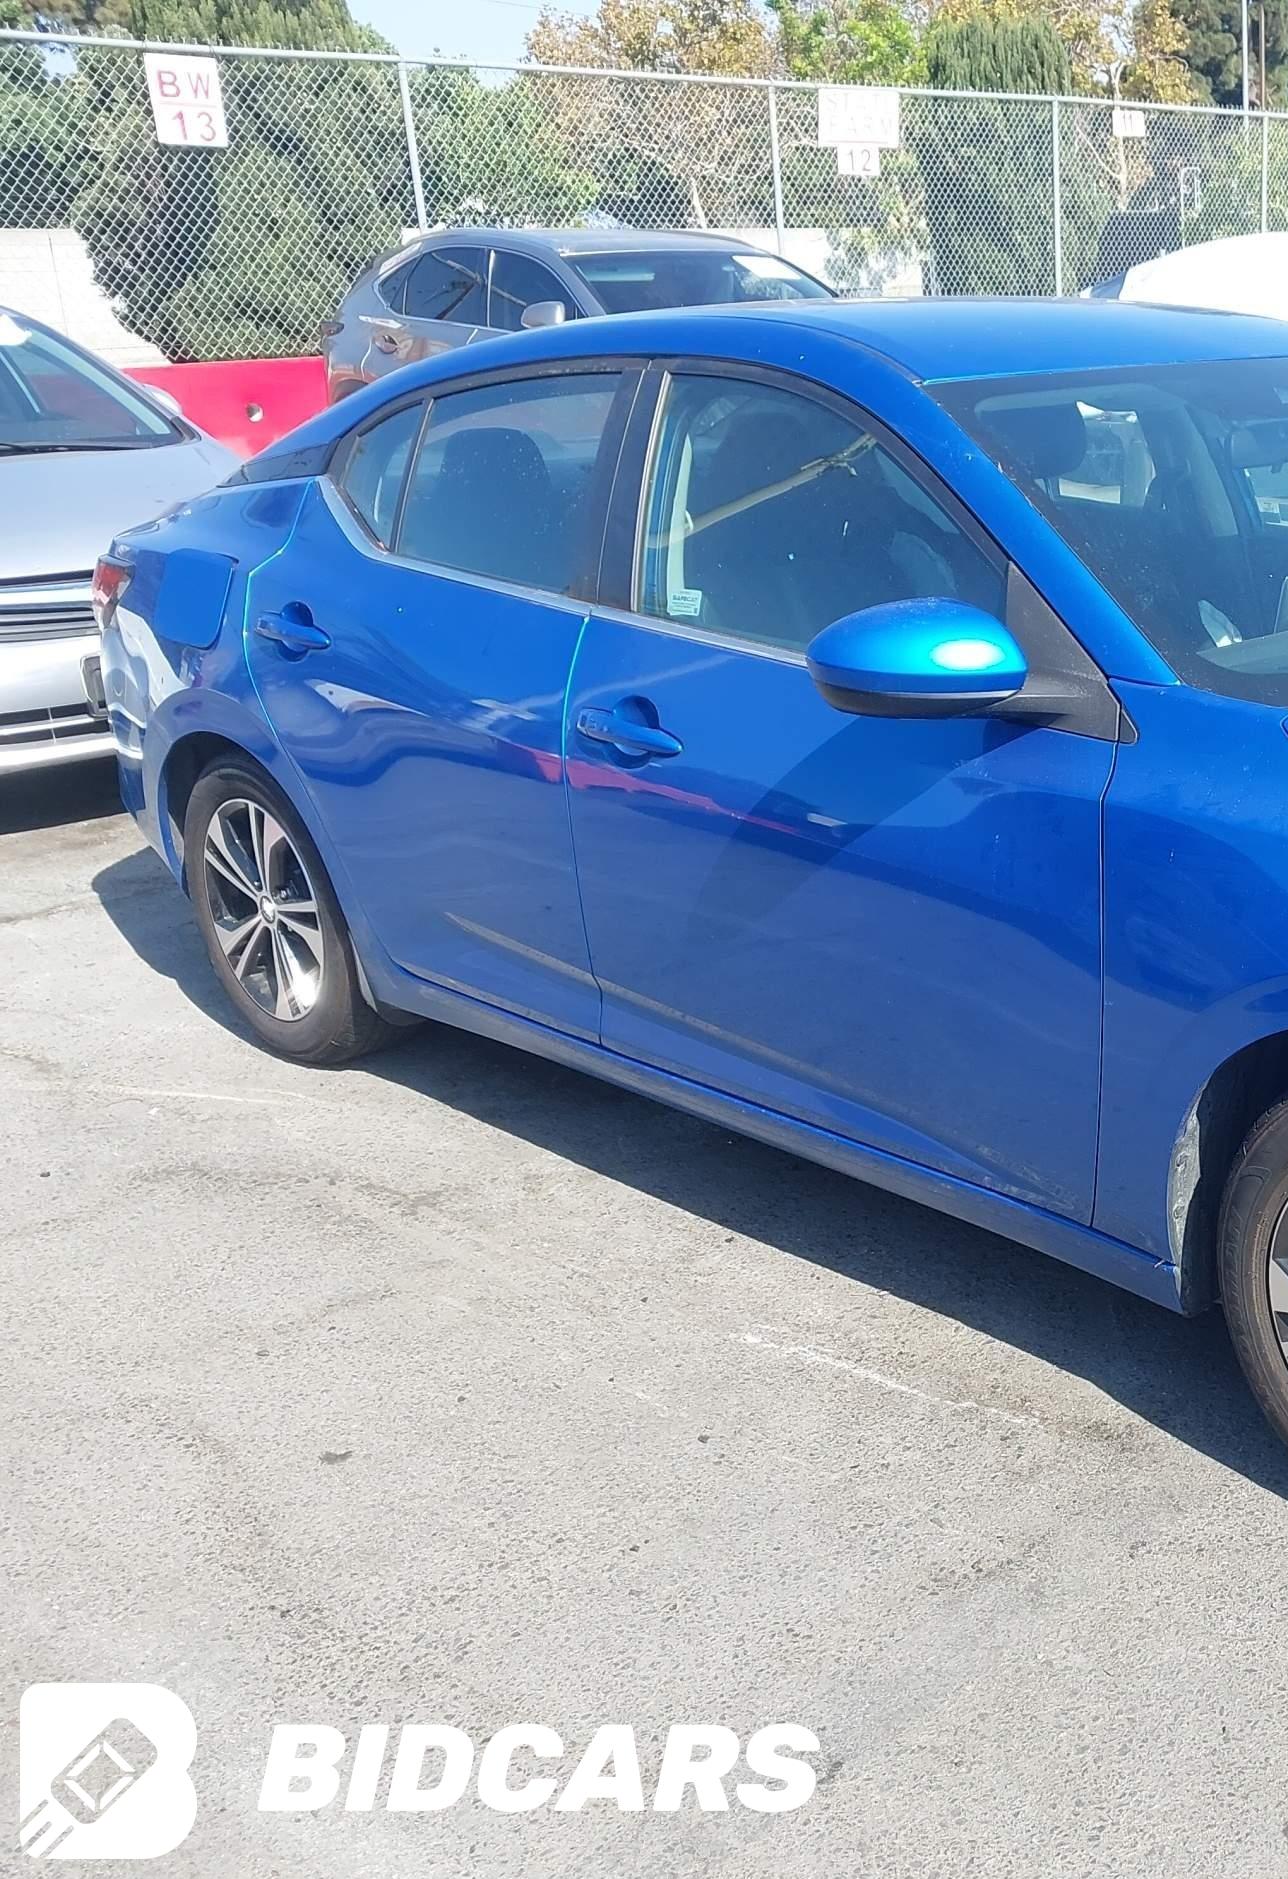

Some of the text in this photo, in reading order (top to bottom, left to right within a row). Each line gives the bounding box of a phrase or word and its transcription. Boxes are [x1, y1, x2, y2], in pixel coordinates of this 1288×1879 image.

[157, 70, 210, 99] BW
[171, 110, 216, 142] 13
[847, 149, 872, 172] 12
